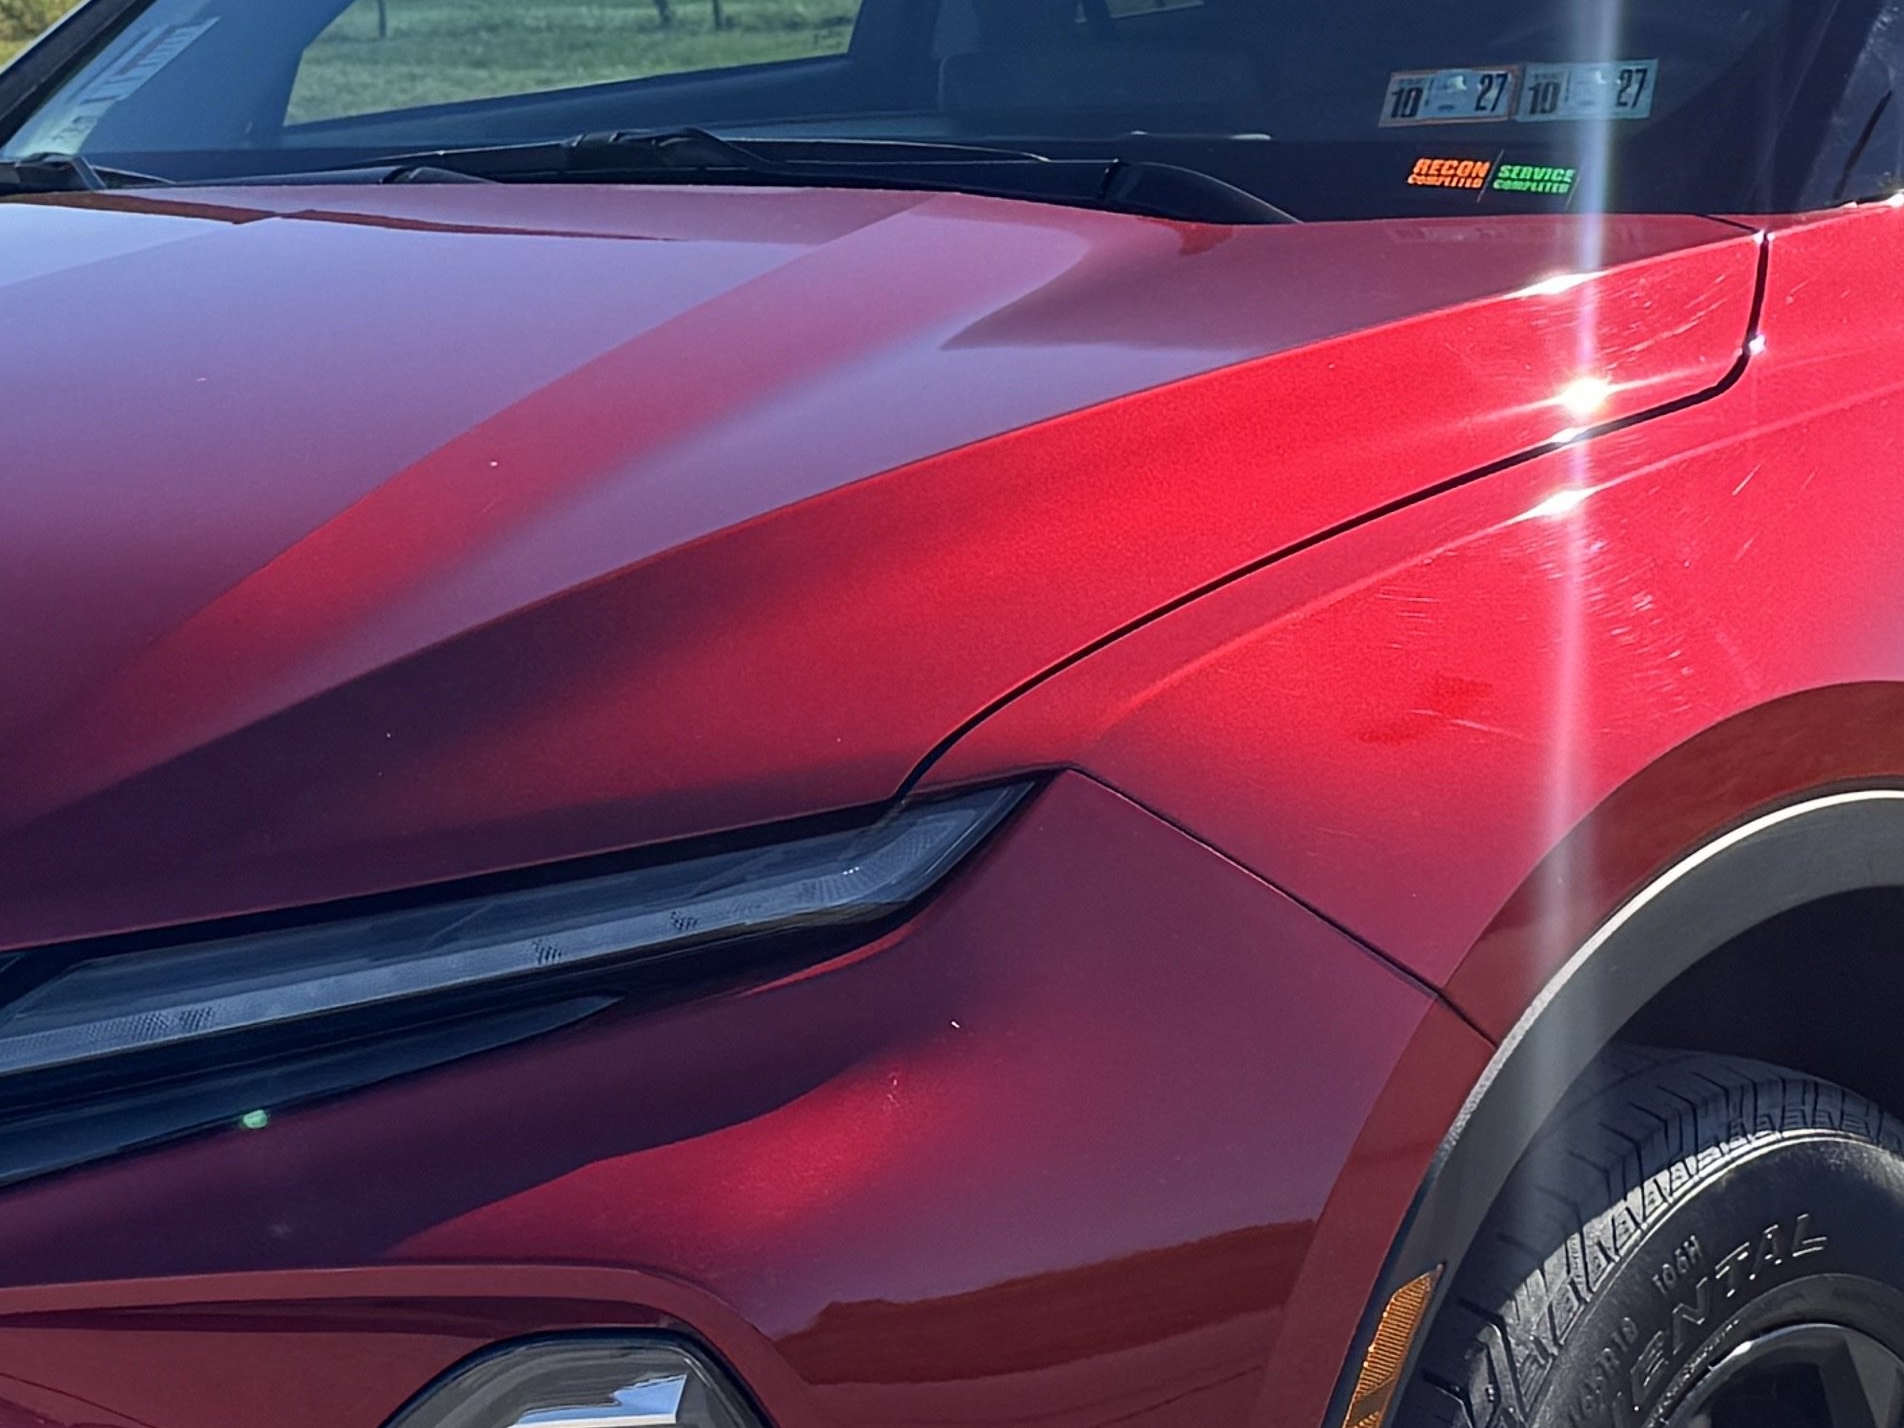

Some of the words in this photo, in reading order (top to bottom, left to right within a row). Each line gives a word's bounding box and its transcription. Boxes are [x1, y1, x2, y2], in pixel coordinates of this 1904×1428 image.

[1391, 86, 1424, 118] 10
[1474, 72, 1509, 113] 27
[1529, 81, 1561, 114] 10
[1615, 67, 1648, 109] 27
[1413, 158, 1491, 178] RECON
[1498, 164, 1576, 183] SERVICE
